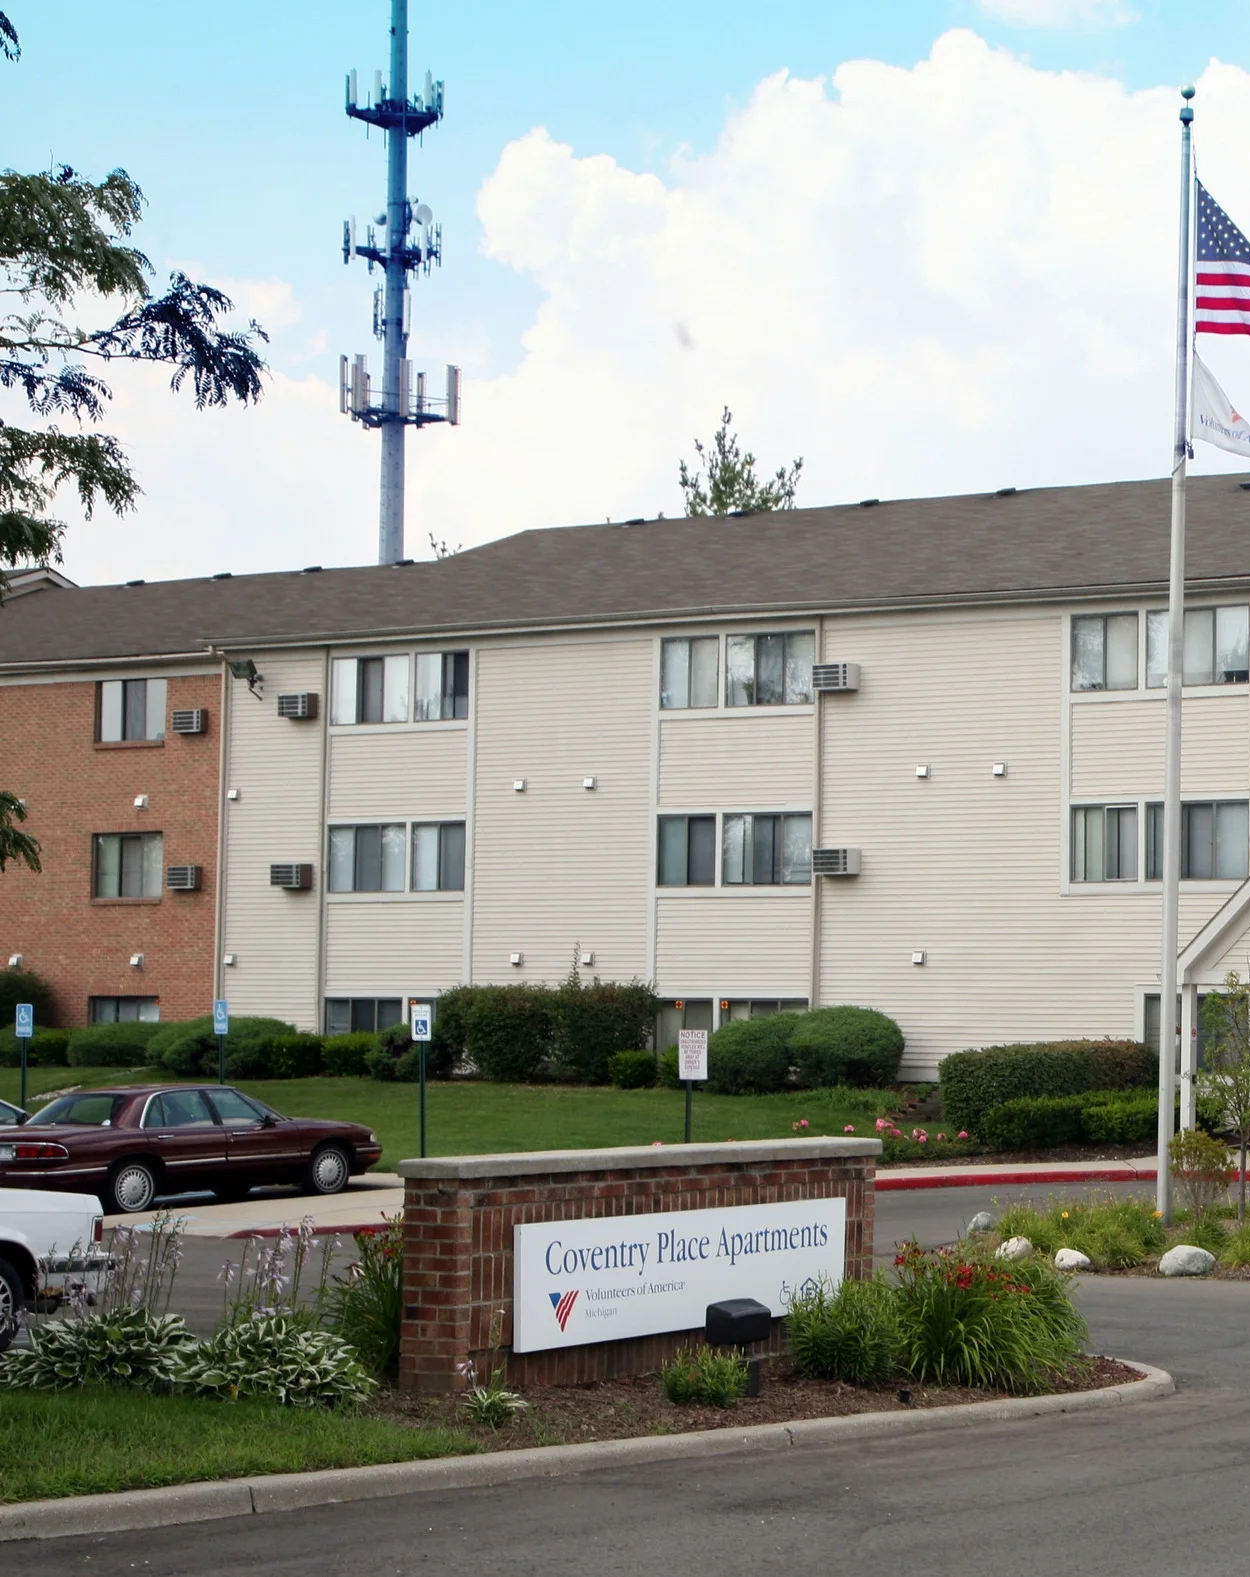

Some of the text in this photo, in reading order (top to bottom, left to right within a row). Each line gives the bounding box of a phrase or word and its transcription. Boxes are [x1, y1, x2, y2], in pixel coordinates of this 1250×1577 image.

[545, 1221, 829, 1276] Coventry Place Apartments
[585, 1279, 684, 1302] Volunteers of America
[584, 1306, 618, 1319] Michigan
